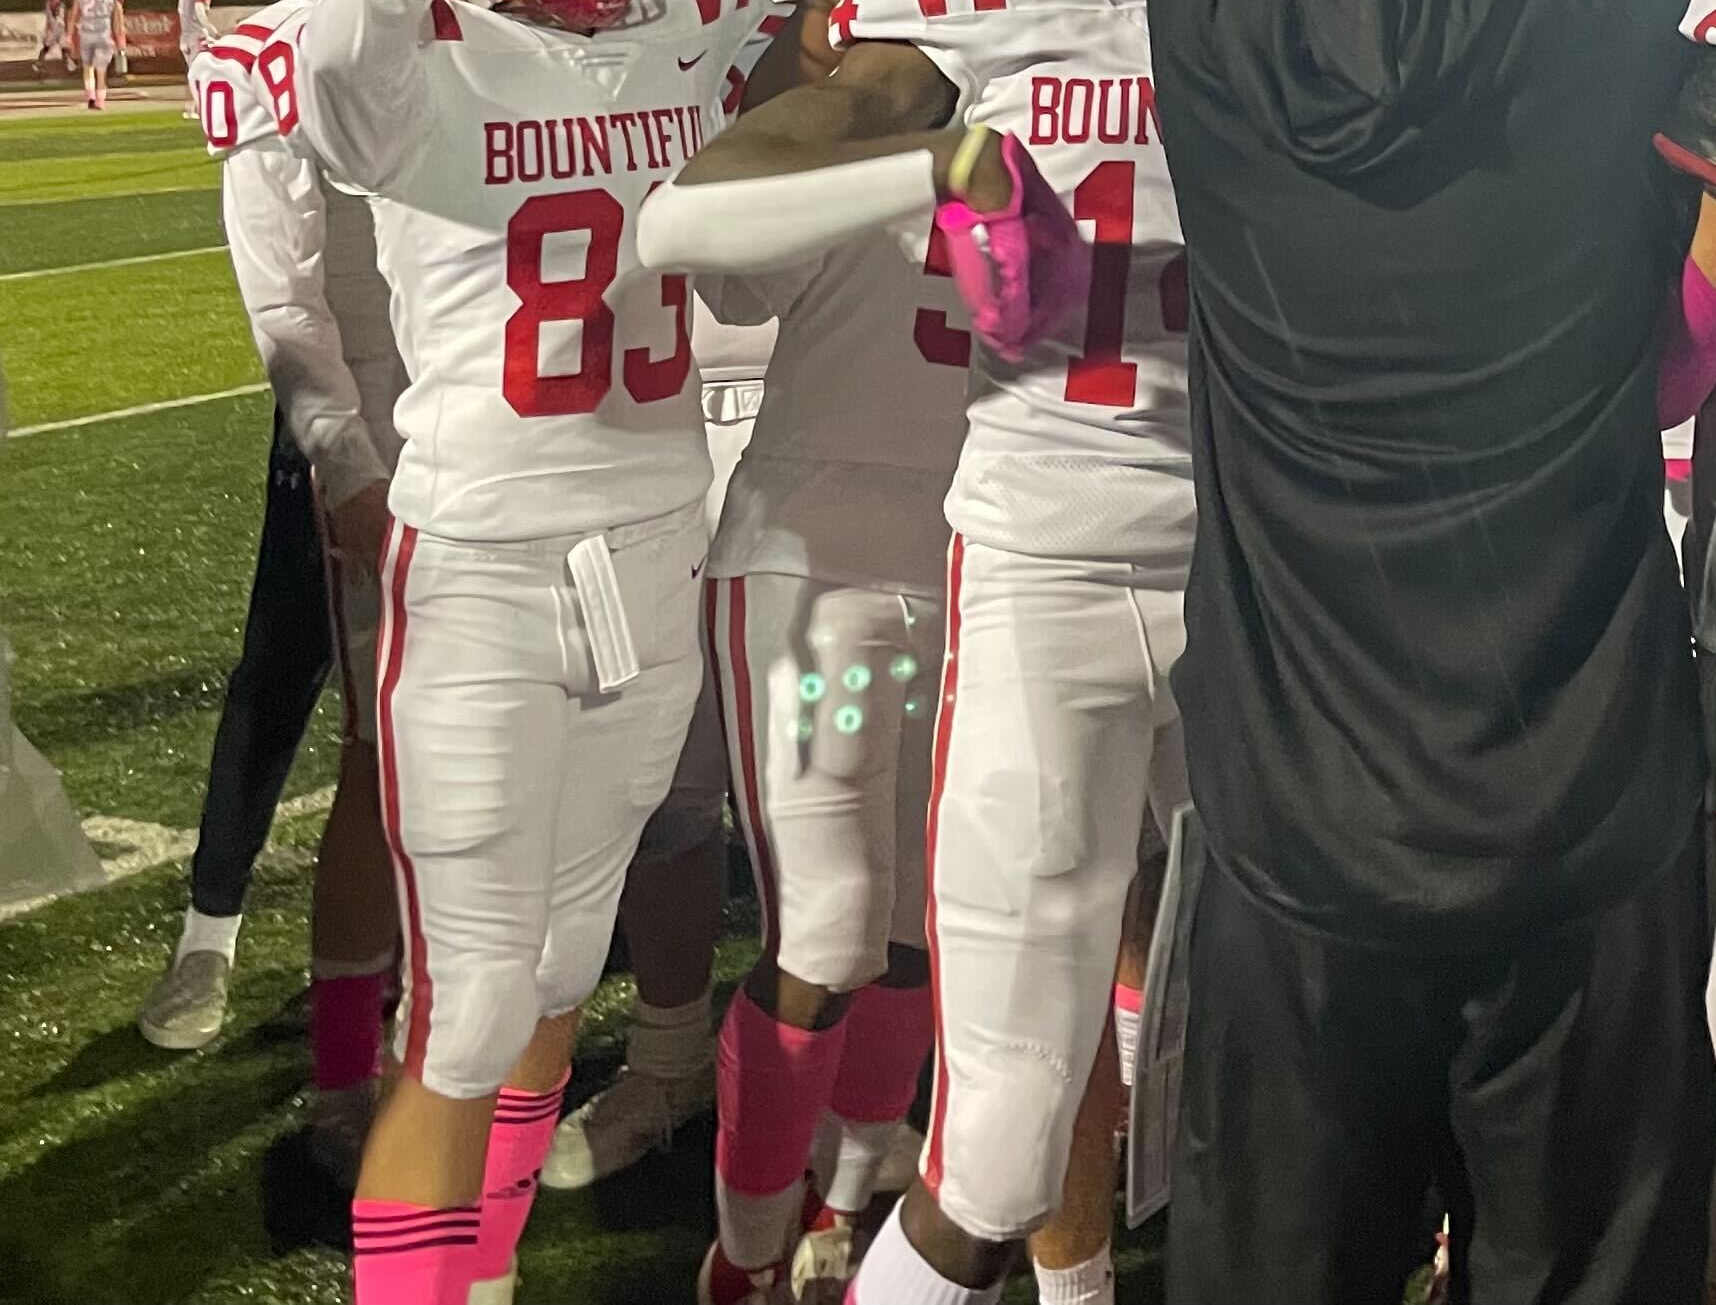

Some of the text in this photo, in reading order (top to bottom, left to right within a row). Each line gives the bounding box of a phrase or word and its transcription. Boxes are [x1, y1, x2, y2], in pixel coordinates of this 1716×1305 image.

[195, 80, 238, 148] 0
[258, 39, 306, 137] 8
[1029, 77, 1162, 145] BOUN
[484, 105, 704, 185] BOUNTIFU
[502, 180, 692, 418] 83
